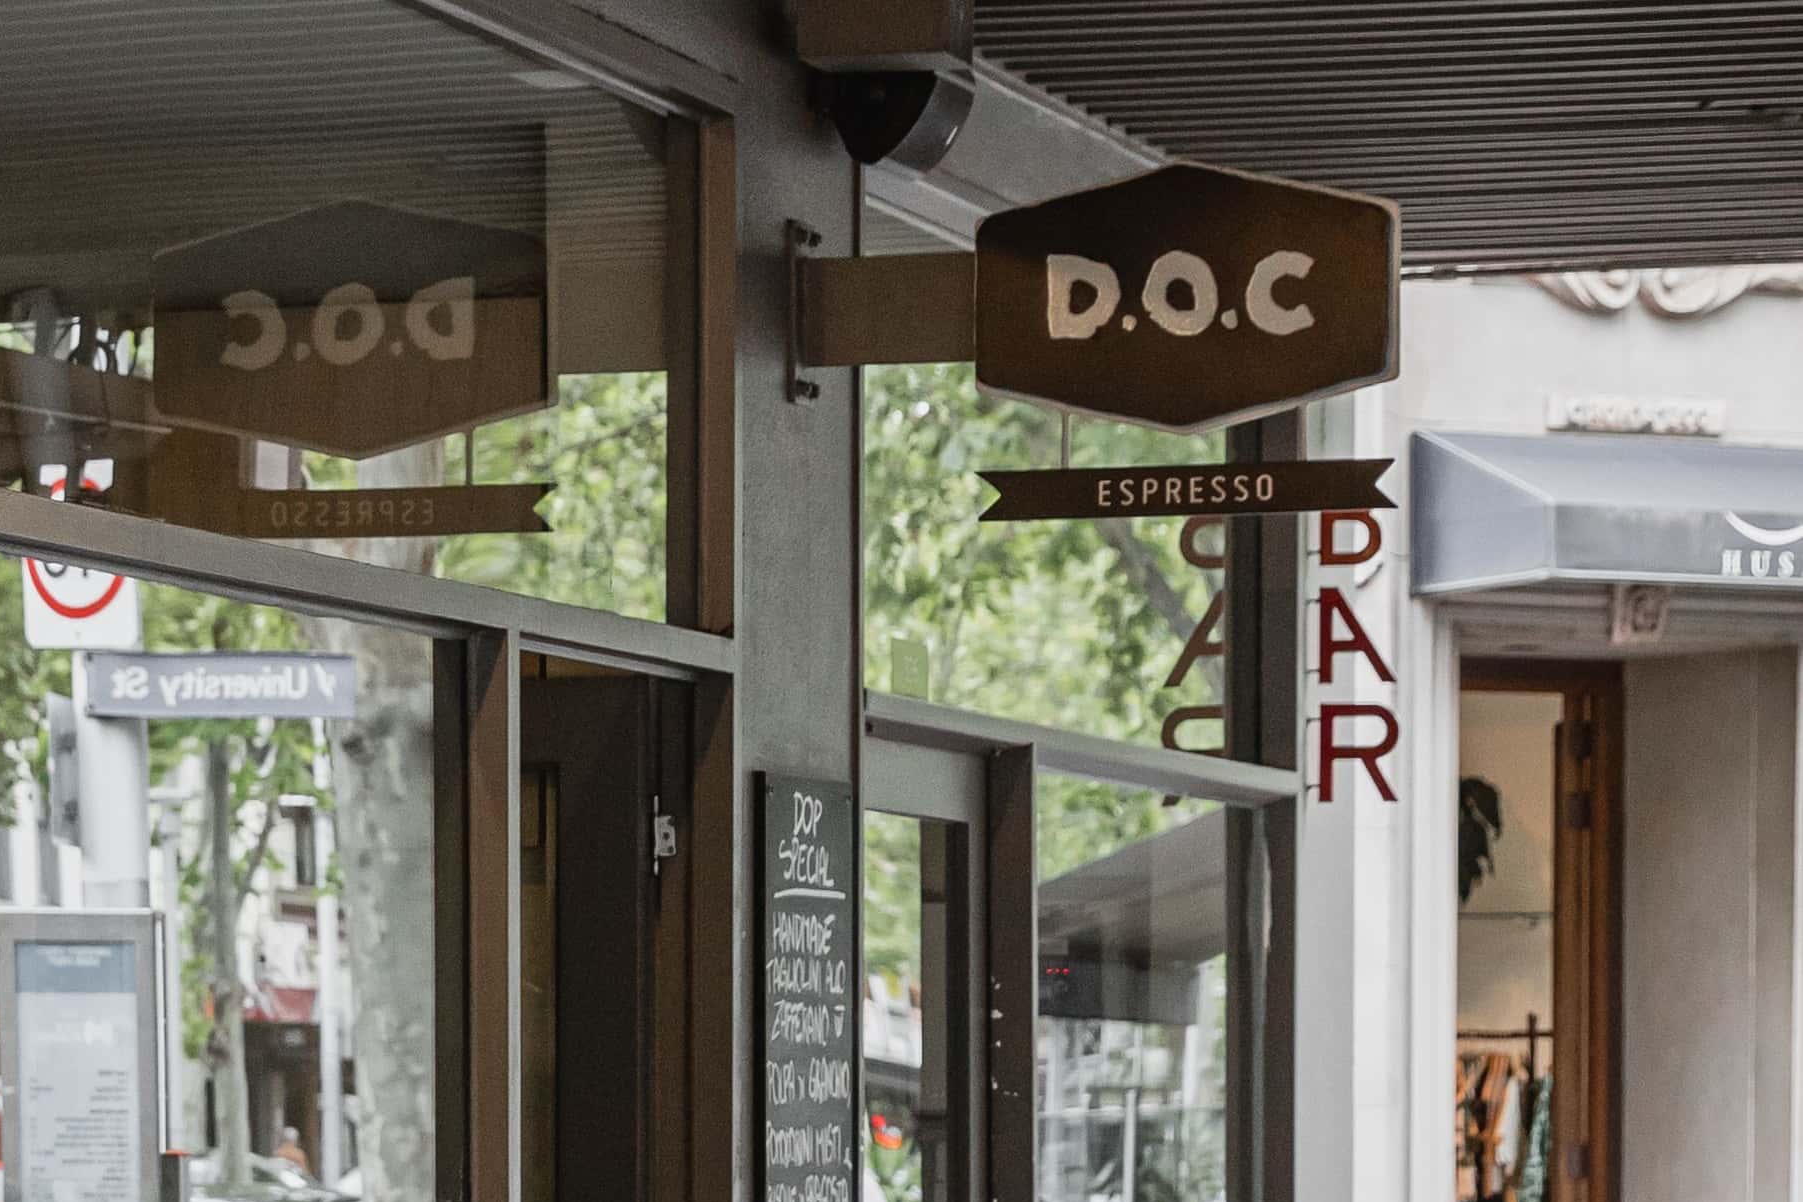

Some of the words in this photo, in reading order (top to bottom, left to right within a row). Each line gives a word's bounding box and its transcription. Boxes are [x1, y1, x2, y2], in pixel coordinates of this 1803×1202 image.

[1045, 249, 1316, 341] D.O.C
[1096, 473, 1275, 508] ESPRESSO
[1721, 549, 1803, 578] HUS
[793, 789, 823, 838] DOP
[778, 836, 835, 888] SPECIAL
[772, 911, 836, 956] HANDMADE
